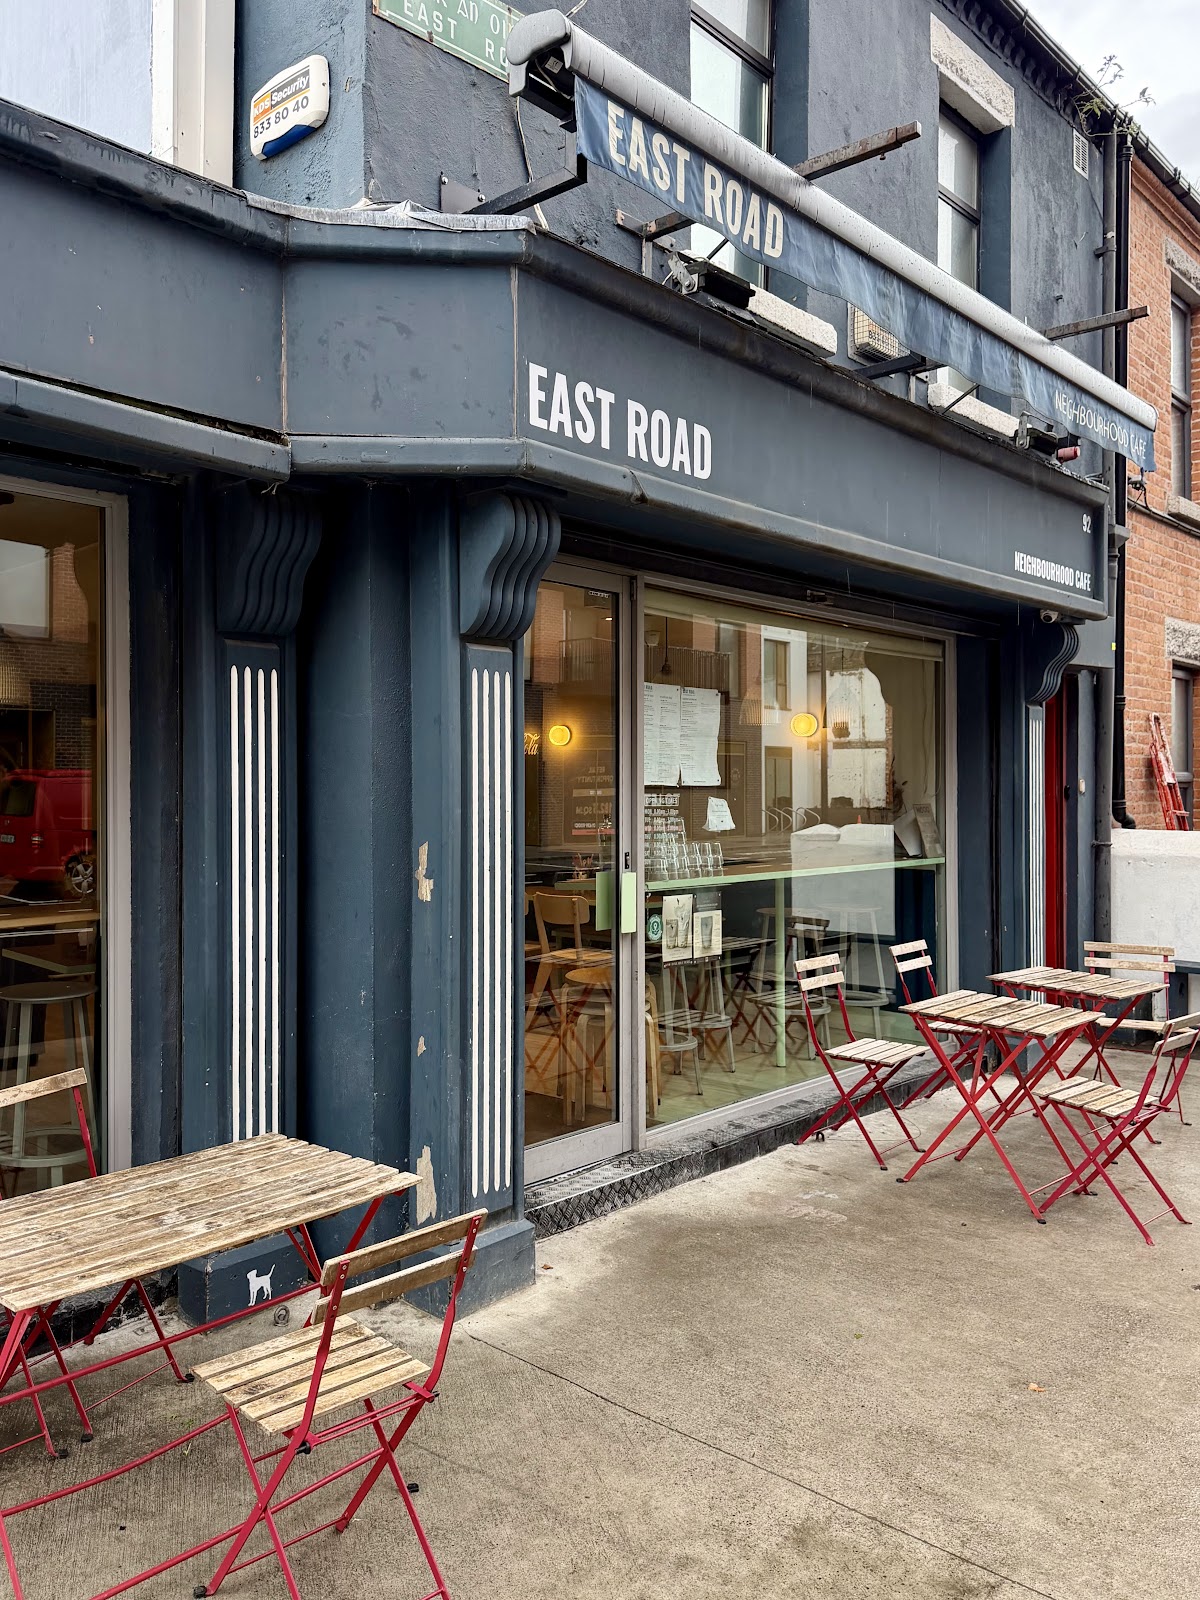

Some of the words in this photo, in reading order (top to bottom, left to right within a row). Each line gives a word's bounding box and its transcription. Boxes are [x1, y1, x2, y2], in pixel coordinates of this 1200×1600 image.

[403, 0, 458, 39] EAST
[485, 37, 509, 67] RO
[254, 98, 270, 116] KDS
[271, 75, 310, 105] Security
[254, 116, 271, 139] 833
[274, 106, 289, 125] 80
[292, 95, 309, 113] 40
[607, 100, 690, 204] EAST
[704, 162, 784, 259] ROAD
[529, 362, 615, 450] EAST
[627, 398, 712, 480] ROAD
[1055, 389, 1128, 448] NEIGHBOURHOOD
[1130, 434, 1147, 460] CAFE
[1082, 513, 1091, 533] 92
[1014, 551, 1074, 587] NEIGHBOURHOOD
[1075, 570, 1091, 592] CAFE
